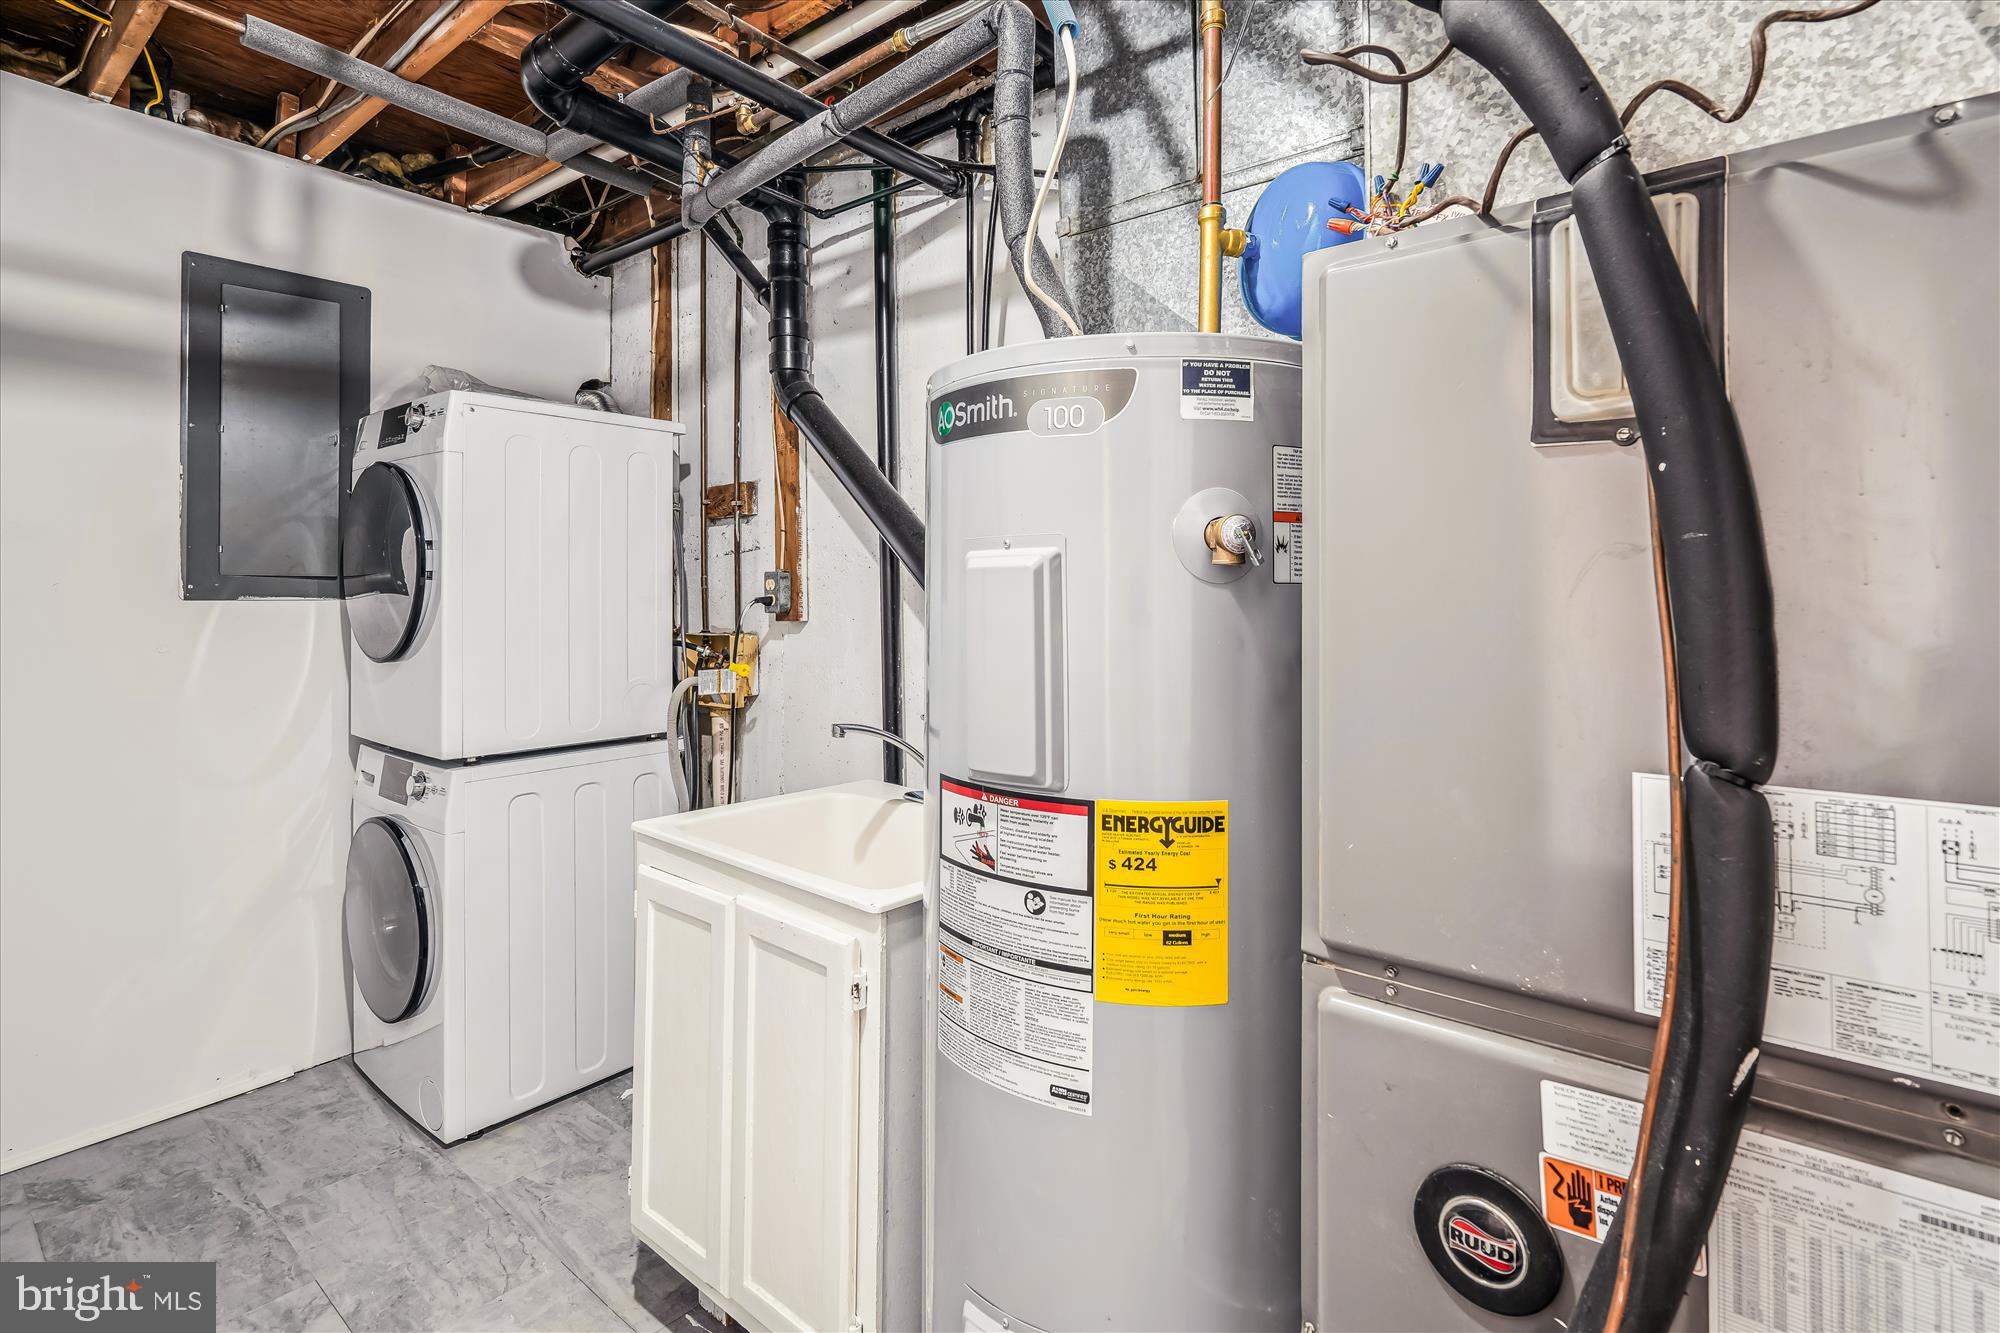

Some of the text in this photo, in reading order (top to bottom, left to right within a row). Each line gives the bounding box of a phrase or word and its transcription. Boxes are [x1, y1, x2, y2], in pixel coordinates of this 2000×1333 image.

[1023, 384, 1112, 398] SIGNATURE
[1044, 405, 1085, 431] 100
[989, 795, 1019, 807] DANGER
[1102, 814, 1225, 835] ENERGYGUIDE
[1108, 857, 1158, 872] $ 424
[972, 941, 998, 956] IMPORTANT
[1001, 950, 1036, 966] IMPORTANTE
[1450, 1226, 1514, 1264] RUUD
